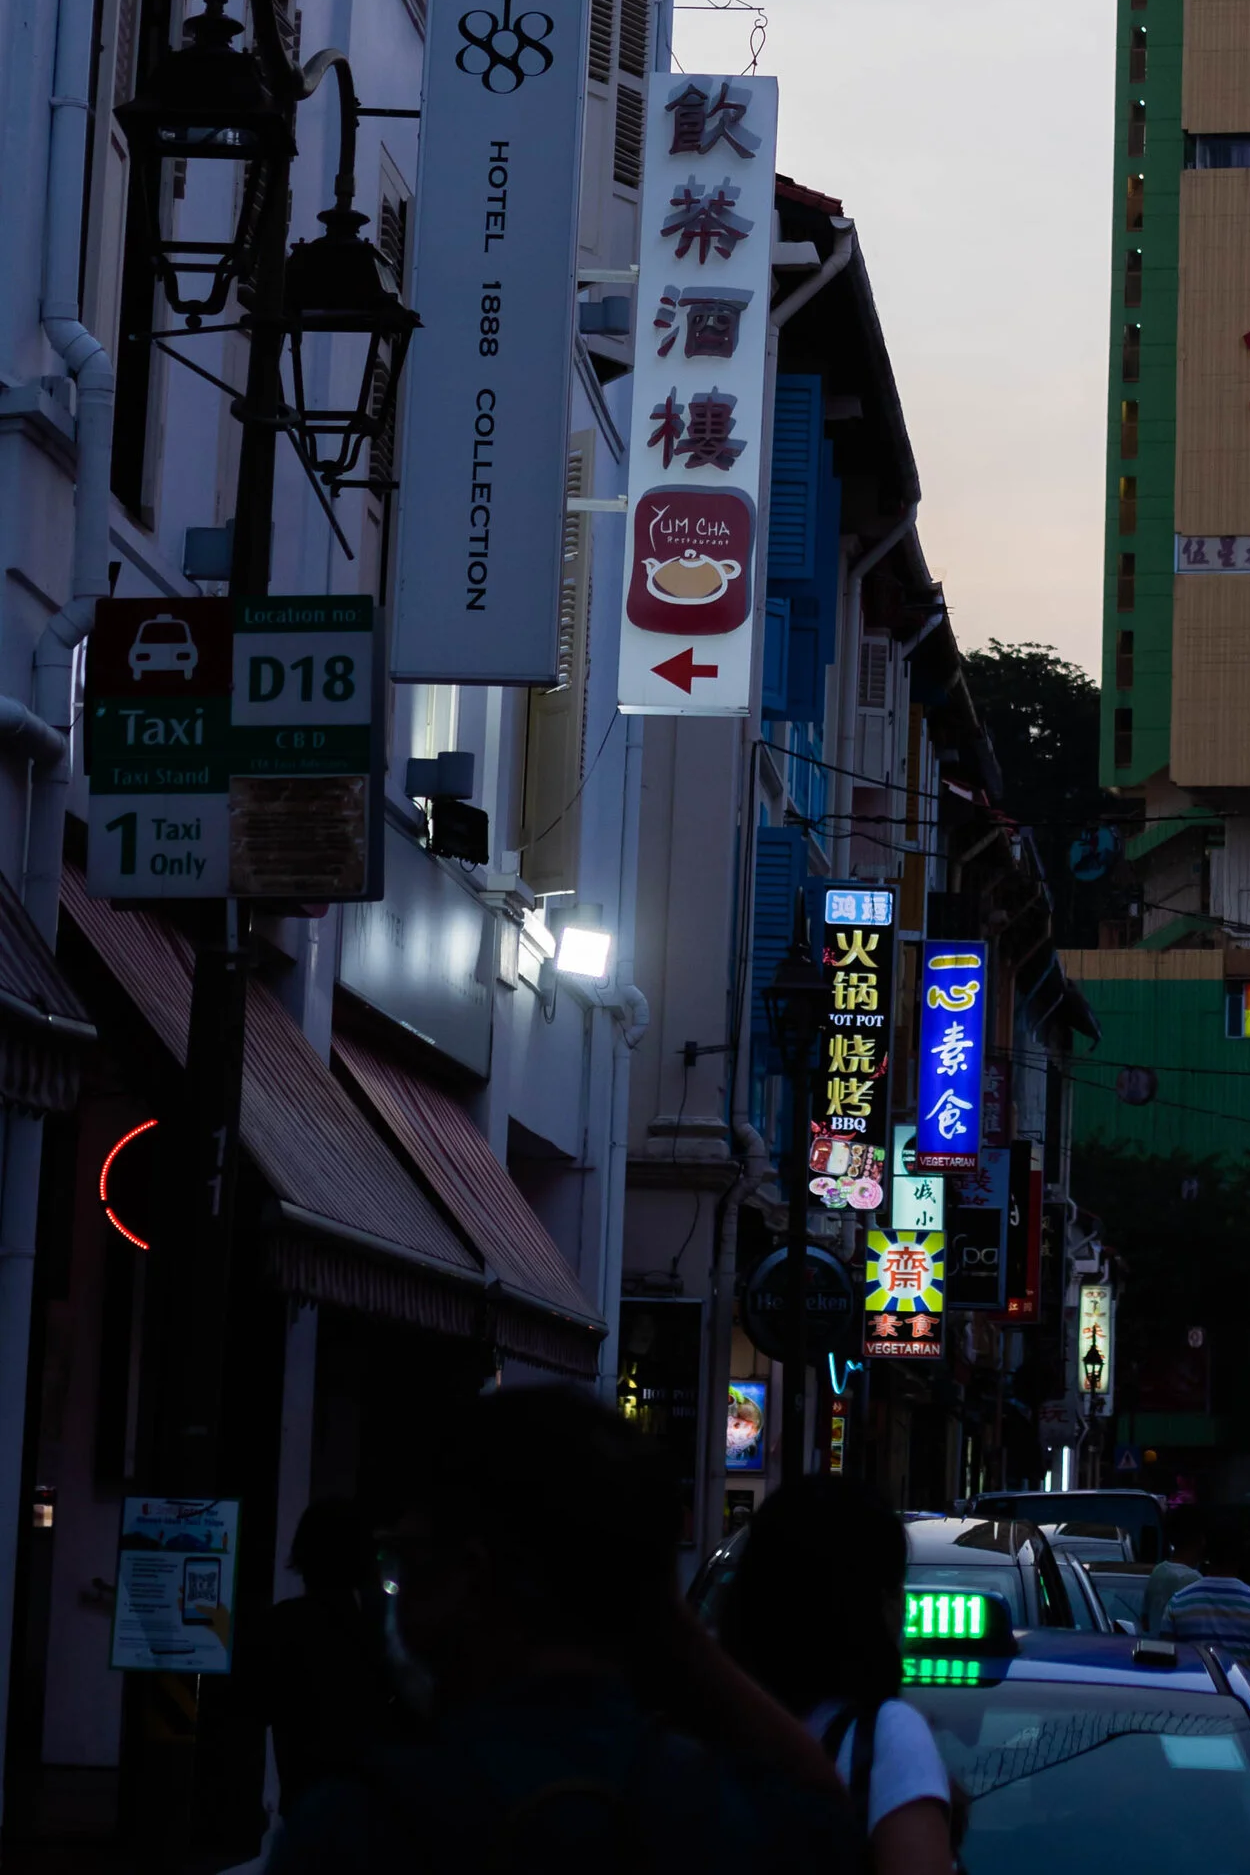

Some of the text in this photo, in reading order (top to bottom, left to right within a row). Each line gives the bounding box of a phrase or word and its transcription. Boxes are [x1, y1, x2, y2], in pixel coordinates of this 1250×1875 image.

[466, 140, 510, 612] HOTEL 1888 COLLECTION
[649, 505, 730, 552] YUM CHA
[667, 535, 730, 546] Restaurant
[244, 606, 326, 623] Location
[249, 656, 355, 702] D18
[118, 707, 205, 746] Taxi
[112, 766, 210, 786] Taxi Stand
[152, 818, 201, 840] Taxi
[105, 812, 137, 875] 1
[150, 853, 206, 879] Only
[832, 930, 880, 1011] 火锅
[828, 1014, 885, 1028] OT POT
[924, 954, 982, 1140] 一心素食
[826, 1034, 876, 1117] 烧烤
[831, 1117, 867, 1134] BBQ
[919, 1155, 976, 1168] VEGETARIAN
[755, 1293, 848, 1312] Heeken
[868, 1313, 940, 1338] 素食
[866, 1342, 940, 1355] VEGETARIAN
